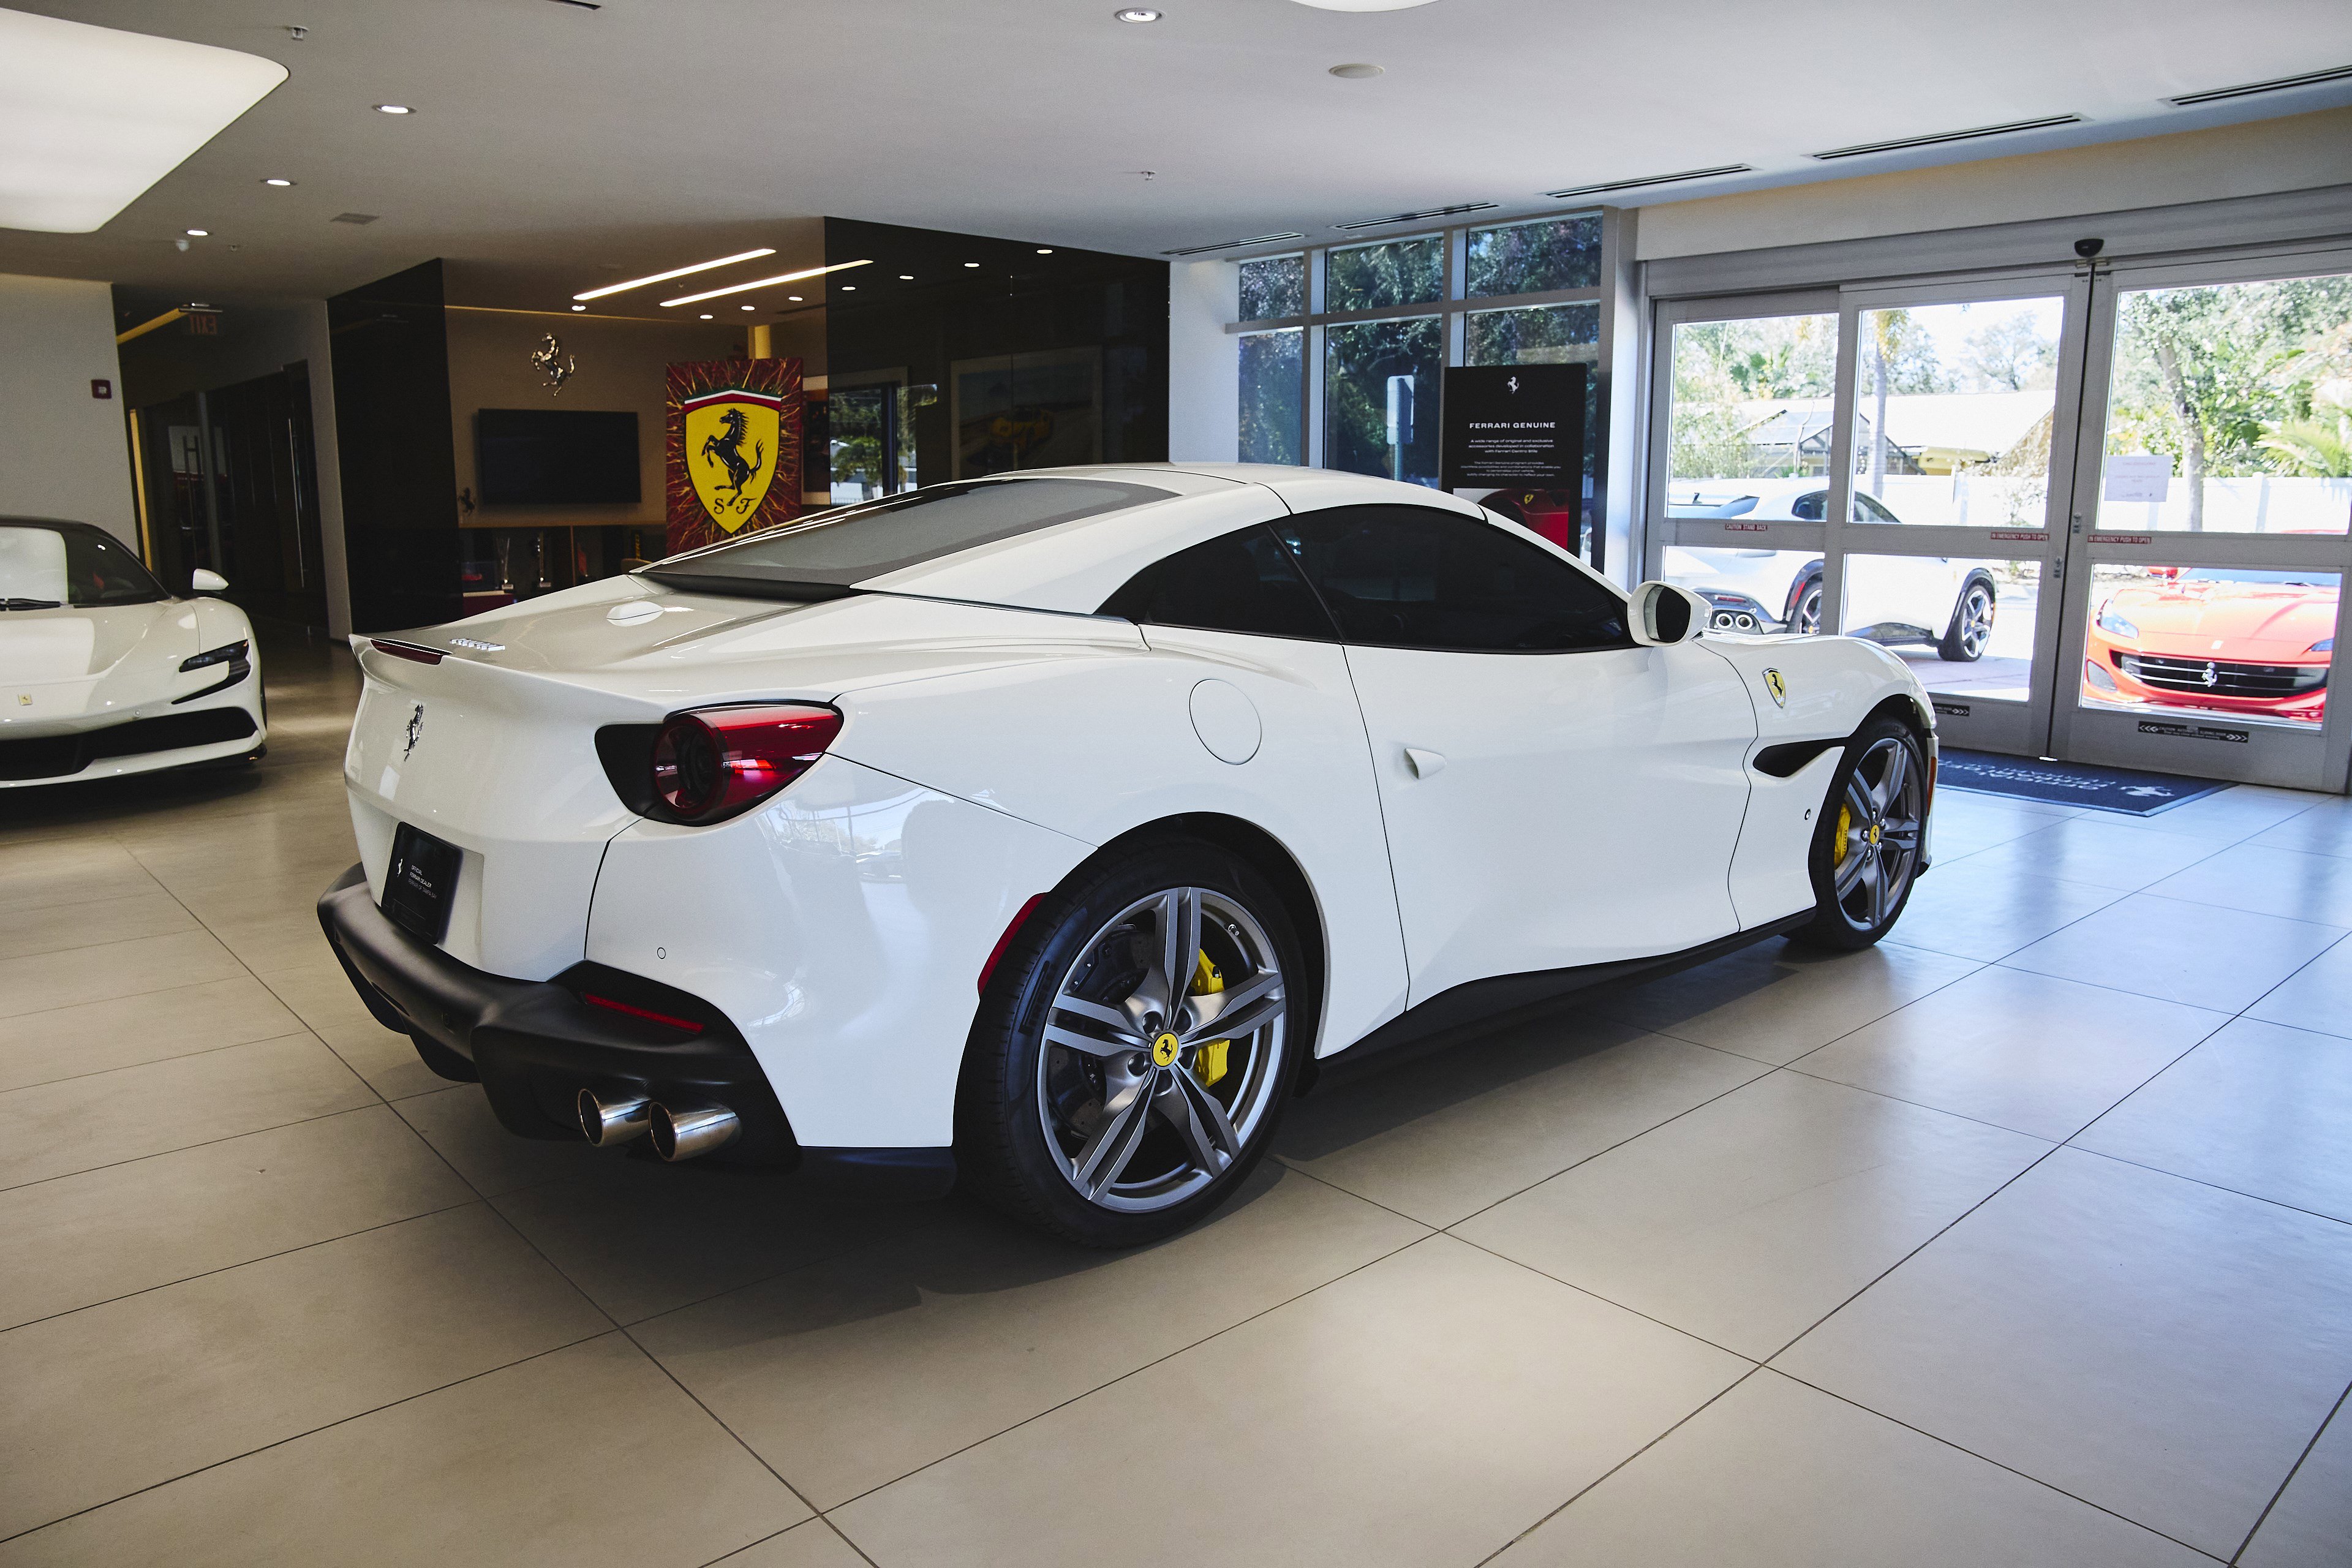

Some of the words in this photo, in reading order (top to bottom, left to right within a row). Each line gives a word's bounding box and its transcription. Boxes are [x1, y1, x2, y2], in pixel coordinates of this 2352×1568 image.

[714, 498, 724, 514] S
[736, 497, 756, 514] F
[412, 865, 423, 875] OFFICIAL
[410, 872, 420, 882] FERRARI
[420, 878, 432, 888] DEALER
